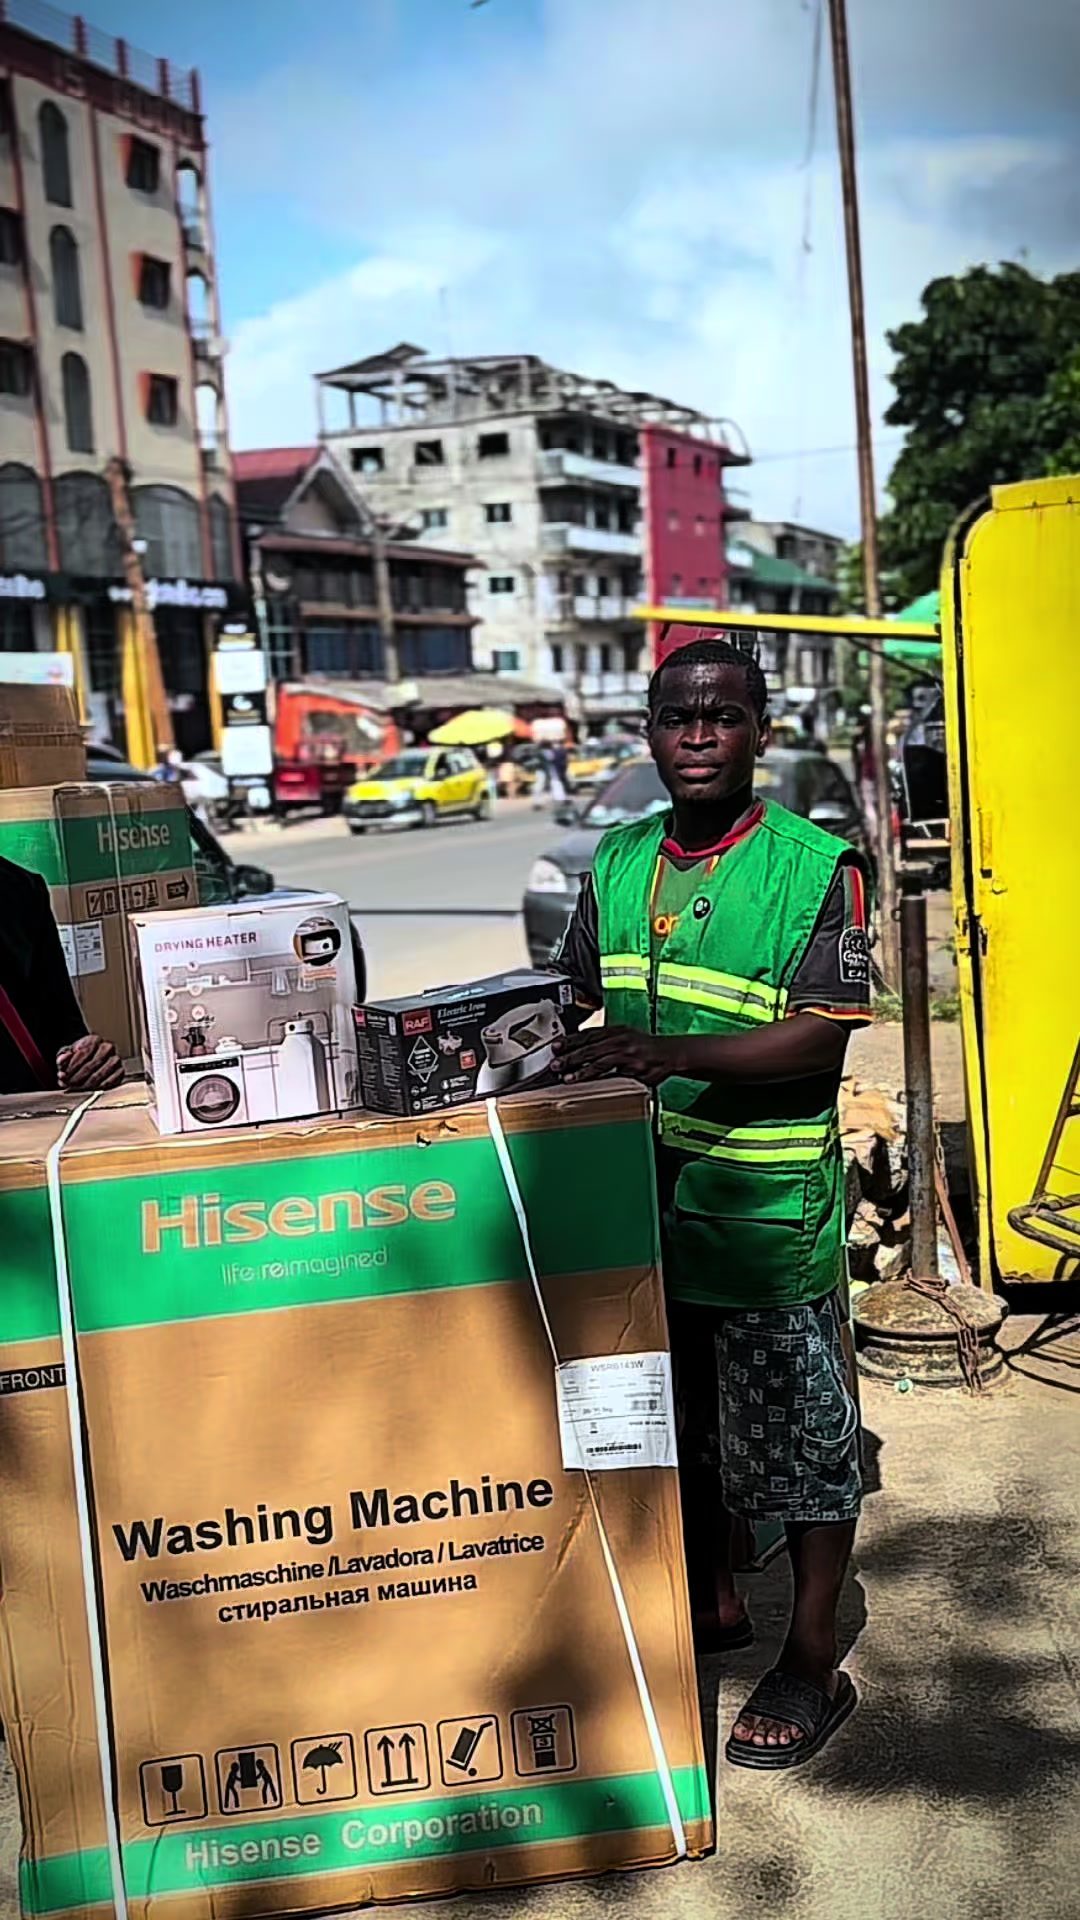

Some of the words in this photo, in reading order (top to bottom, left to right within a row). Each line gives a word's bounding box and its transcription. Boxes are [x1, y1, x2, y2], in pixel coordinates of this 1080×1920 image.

[97, 821, 170, 853] Hsense
[154, 937, 203, 953] DRYING
[206, 932, 257, 948] HEATER
[405, 1016, 430, 1030] RAF
[437, 1005, 468, 1019] Electric
[141, 1178, 457, 1255] Hisense
[222, 1263, 257, 1287] life
[260, 1246, 390, 1282] reimagined
[0, 1367, 66, 1391] FRONT
[112, 1503, 334, 1562] Washing
[349, 1475, 554, 1530] Machine
[217, 1586, 370, 1624] стиральная
[376, 1573, 477, 1602] машина
[184, 1832, 322, 1871] Hisense
[340, 1801, 543, 1850] Corporation
